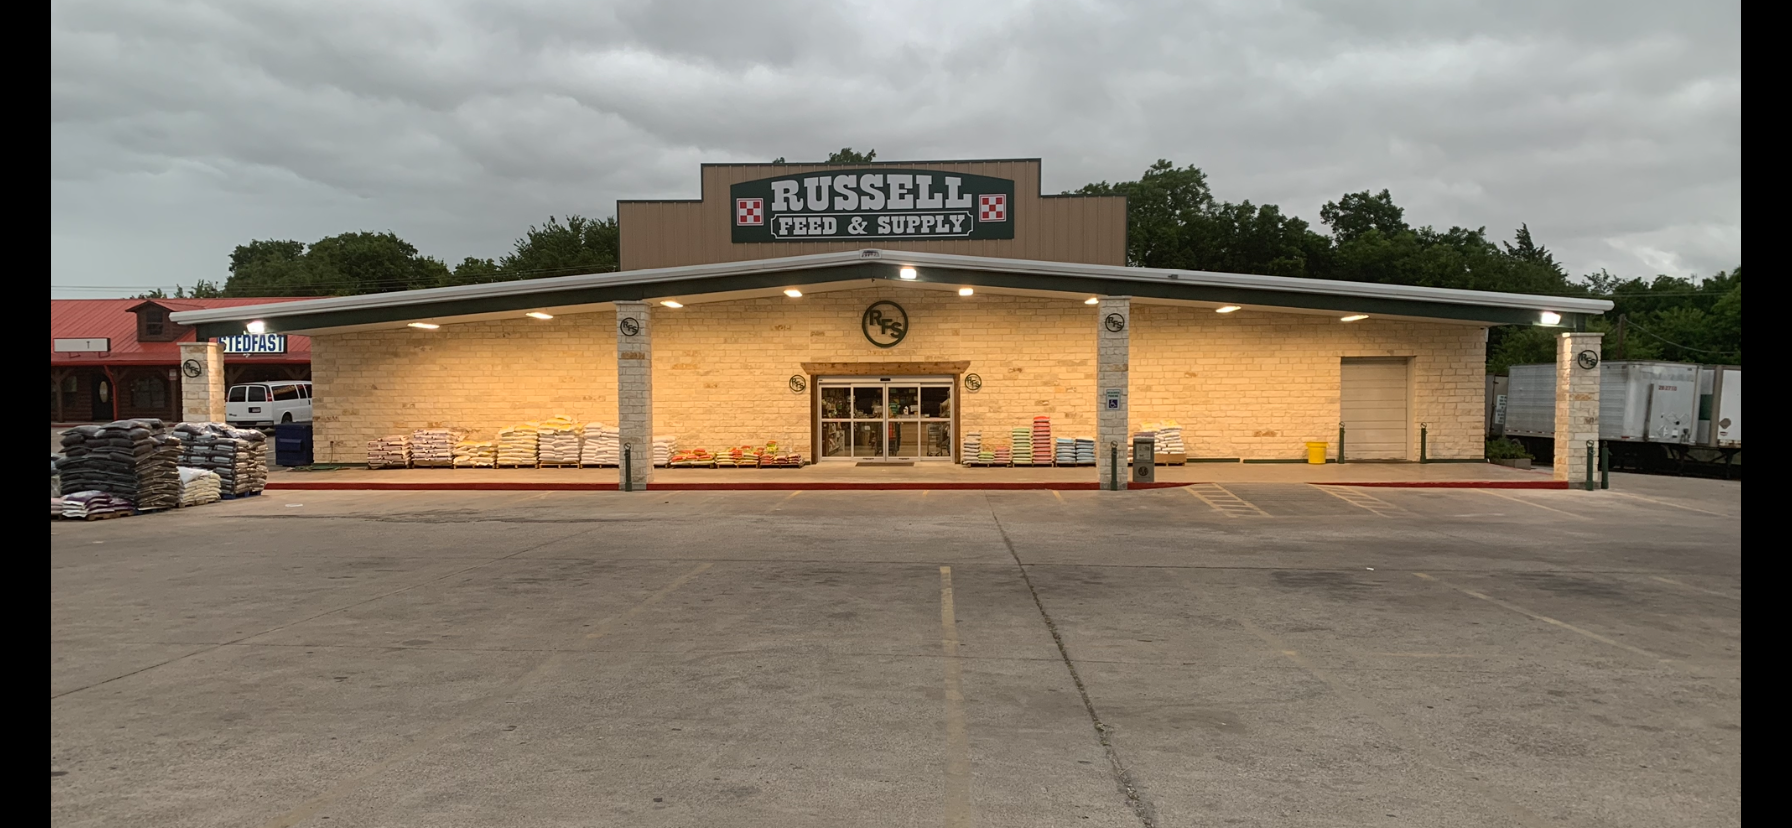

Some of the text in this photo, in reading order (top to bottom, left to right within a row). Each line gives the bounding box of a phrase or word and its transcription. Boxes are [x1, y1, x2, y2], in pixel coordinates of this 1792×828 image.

[771, 174, 973, 211] RUSSELL
[778, 214, 965, 235] FEED & SUPPLY
[868, 308, 906, 341] RFS
[218, 334, 284, 352] STEDFAST
